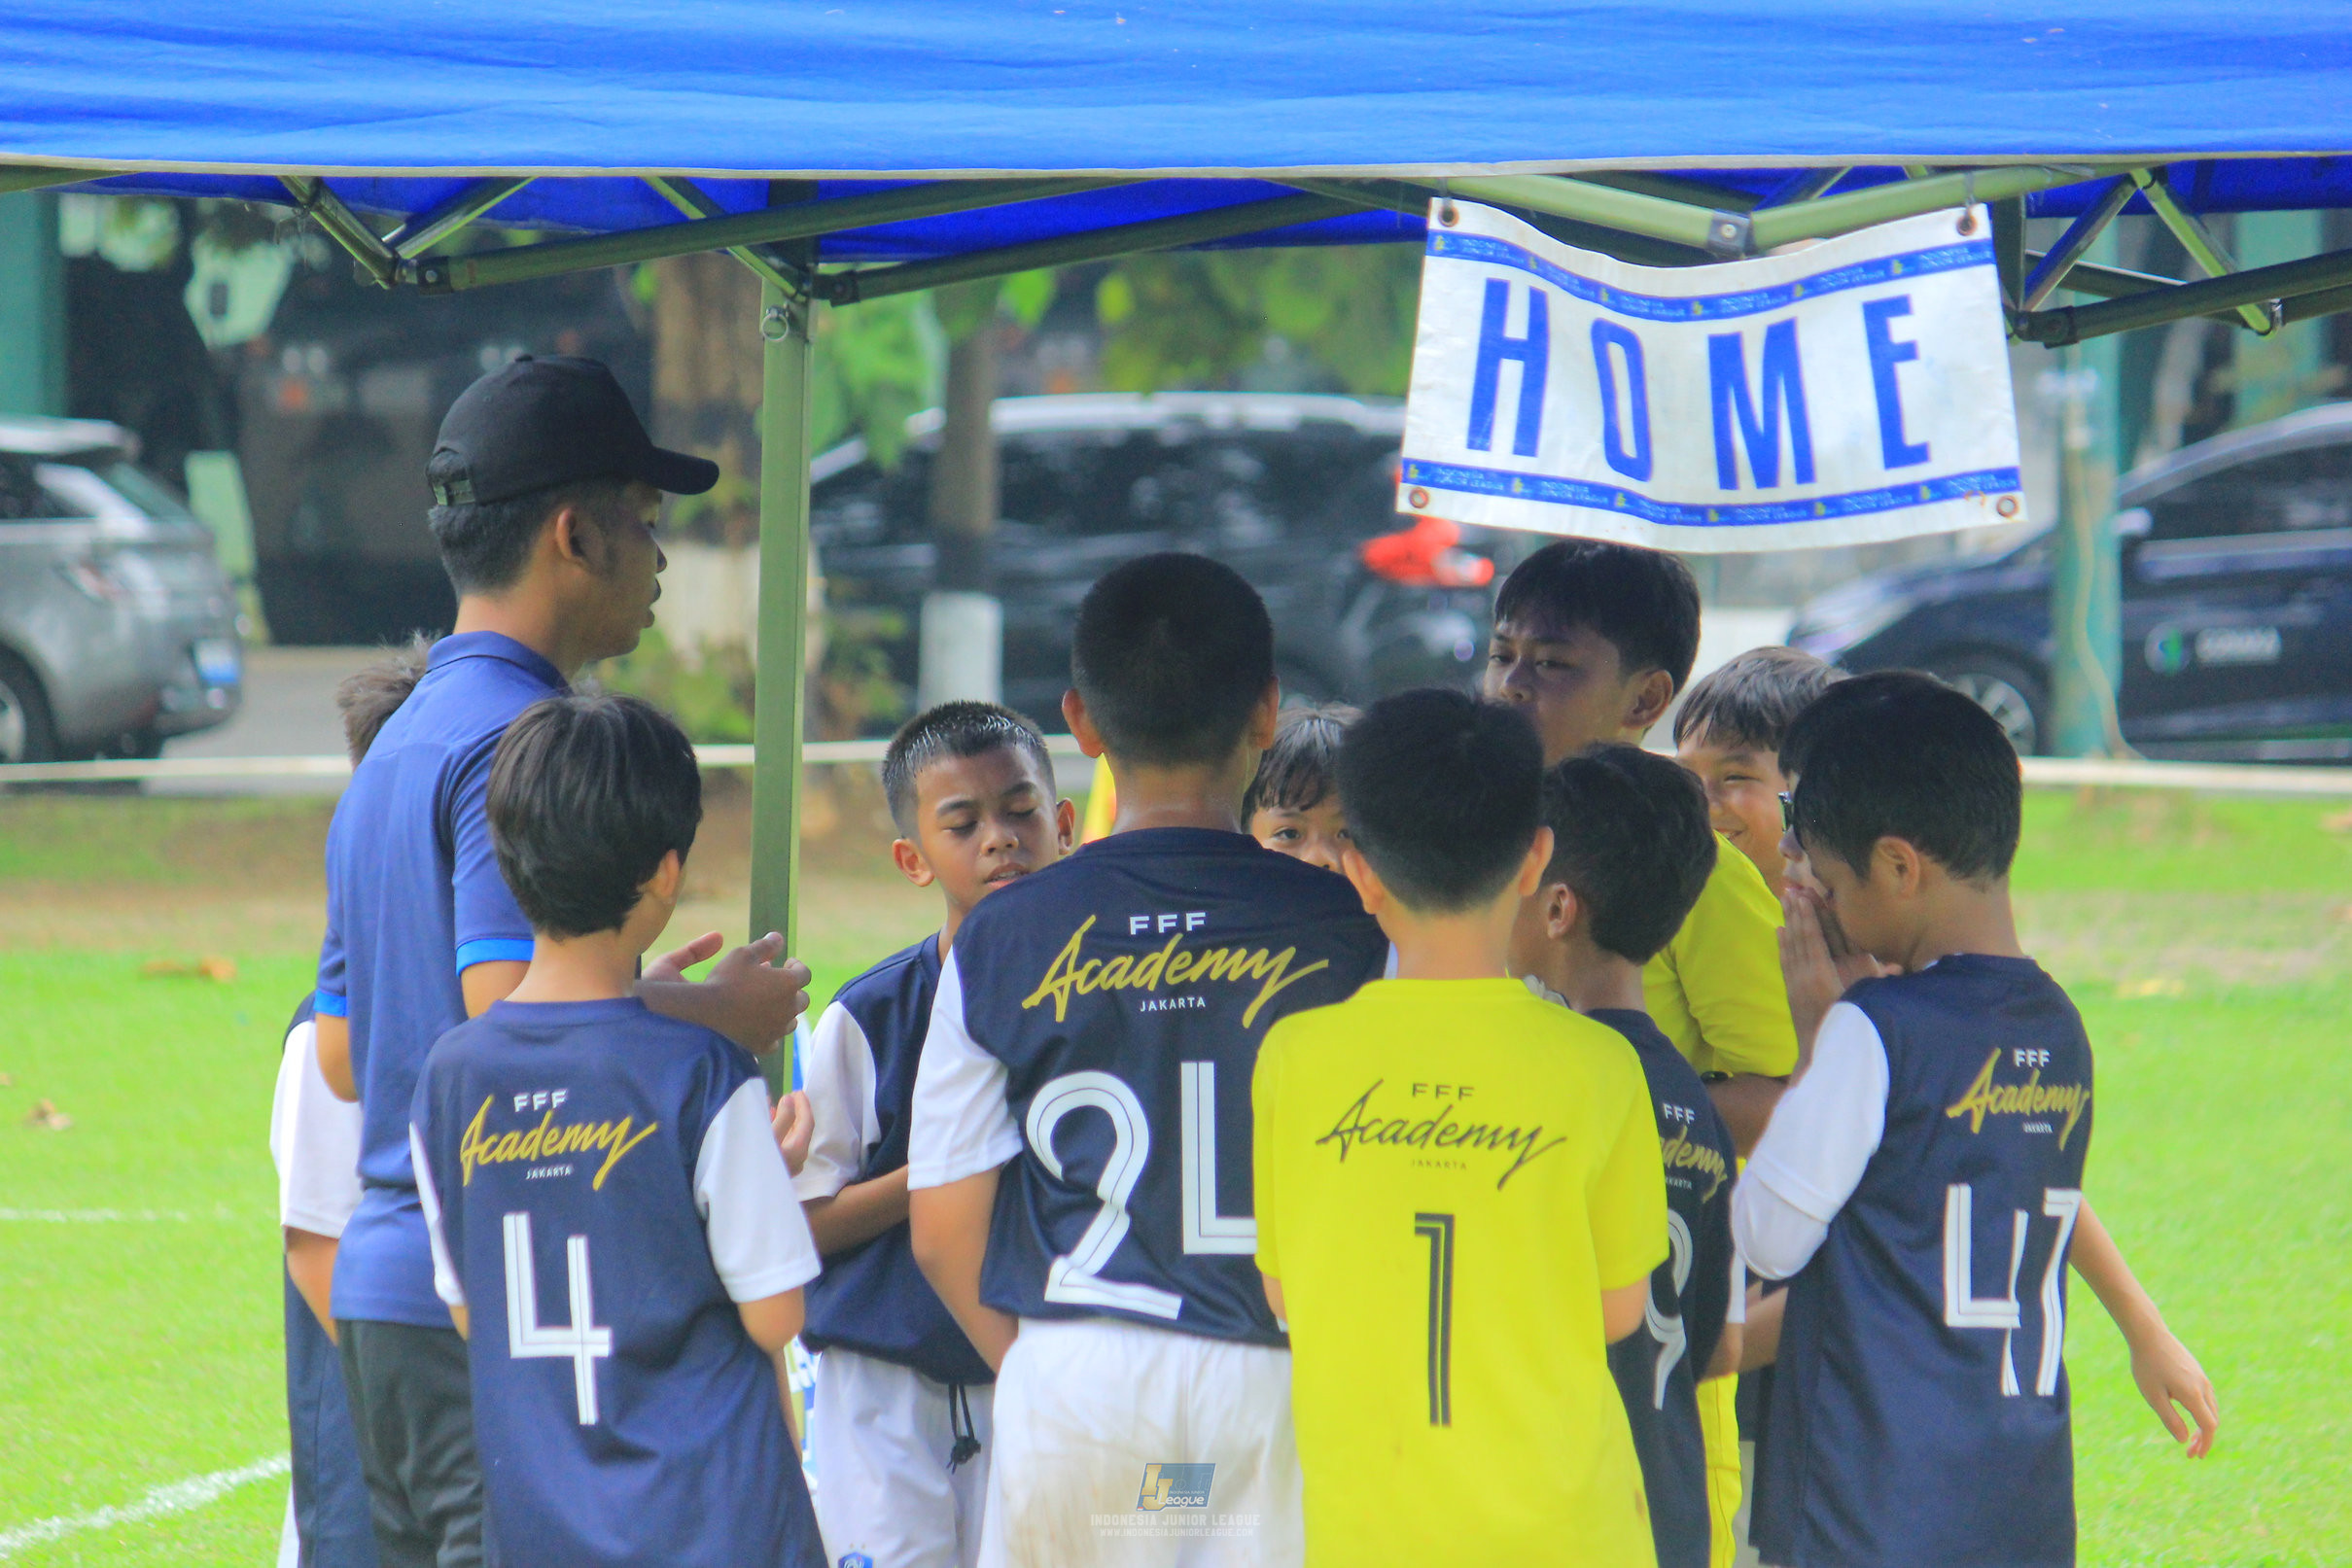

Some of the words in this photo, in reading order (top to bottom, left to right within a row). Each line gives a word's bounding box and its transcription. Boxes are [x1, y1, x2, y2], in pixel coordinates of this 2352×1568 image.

[1466, 278, 1932, 491] HOME
[1021, 914, 1329, 1029] Academy
[1129, 911, 1207, 935] FFF
[1140, 995, 1206, 1013] JAKARTA
[512, 1088, 568, 1113] FFF
[1412, 1082, 1475, 1101] FFF
[1946, 1047, 2091, 1151] Academy
[2014, 1048, 2051, 1067] FFF
[459, 1094, 659, 1192] Academy
[1316, 1078, 1568, 1192] Academy
[1663, 1102, 1696, 1125] FFF
[525, 1165, 574, 1180] JAKARTA
[503, 1211, 613, 1426] 4
[1414, 1211, 1456, 1428] 1
[1945, 1183, 2083, 1397] 47
